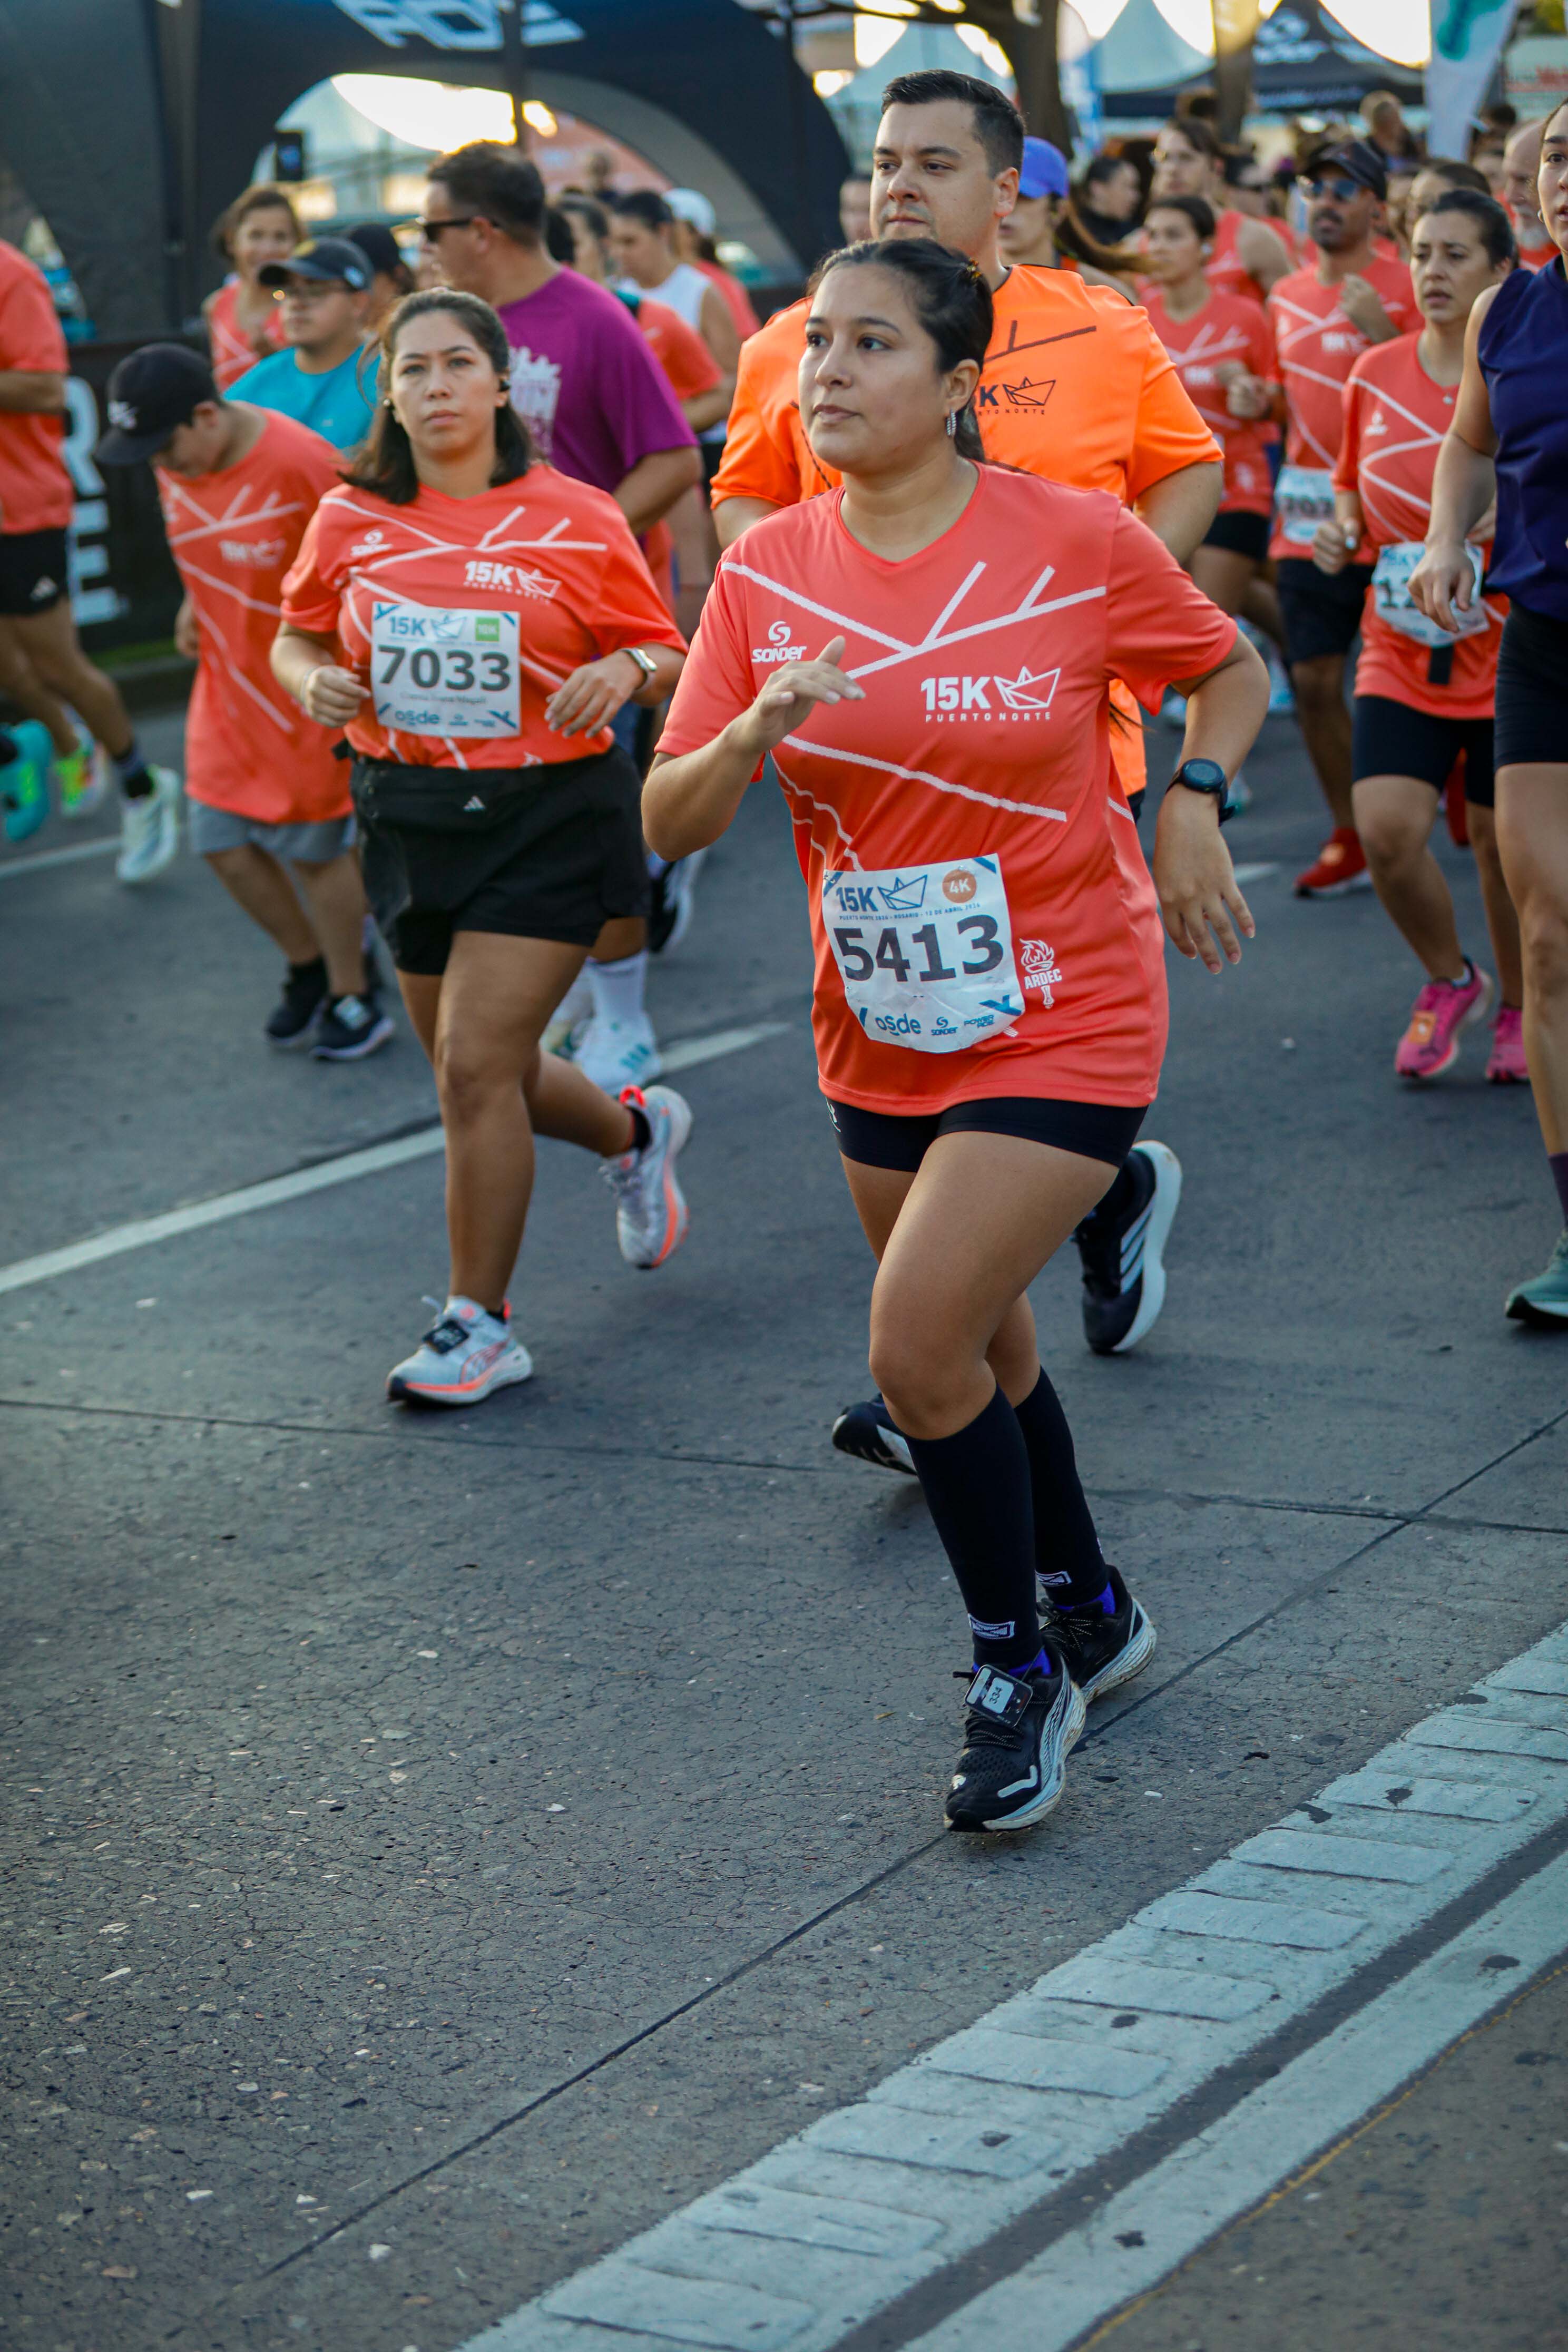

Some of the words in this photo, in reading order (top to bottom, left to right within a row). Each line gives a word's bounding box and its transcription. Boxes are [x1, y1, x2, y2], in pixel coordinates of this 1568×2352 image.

[465, 560, 515, 586] 15K
[388, 615, 426, 636] 15K
[378, 644, 511, 692] 7033
[920, 676, 991, 711] 15K
[395, 710, 440, 726] osde
[925, 713, 991, 723] PUERTO
[999, 711, 1051, 721] NORTE
[949, 878, 971, 894] 4K
[836, 886, 879, 912] 15K
[834, 914, 1004, 982] 5413
[1024, 968, 1063, 989] ARDEC
[875, 1013, 922, 1036] osde
